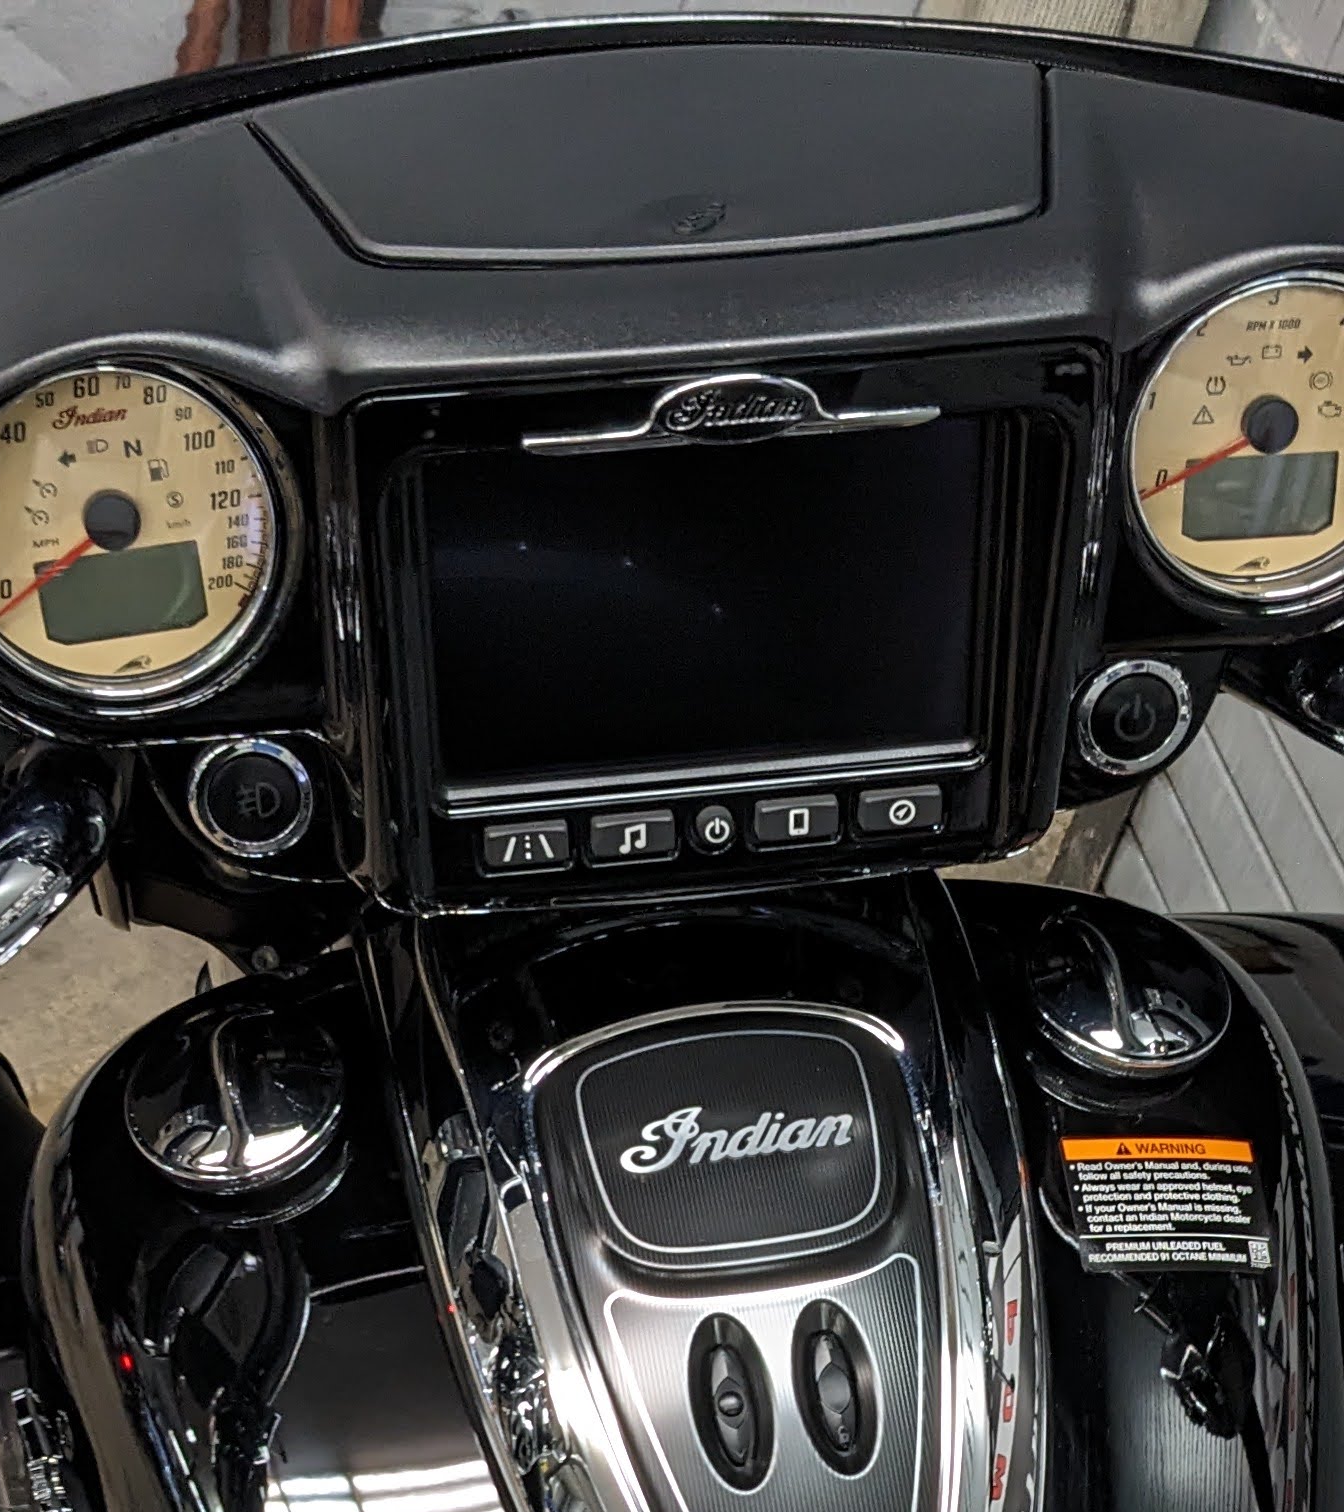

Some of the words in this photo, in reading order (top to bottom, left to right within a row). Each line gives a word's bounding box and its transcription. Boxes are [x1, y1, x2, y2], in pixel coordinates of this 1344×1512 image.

[1246, 319, 1267, 331] RPM
[1278, 318, 1301, 330] 1000
[72, 376, 101, 399] 60
[115, 375, 132, 390] 70
[35, 391, 55, 408] 50
[143, 384, 168, 405] 80
[1147, 391, 1156, 411] 1
[52, 405, 129, 430] Indian
[175, 406, 193, 422] 90
[666, 388, 805, 432] Indian
[0, 421, 27, 445] 40
[183, 430, 216, 452] 100
[215, 459, 235, 475] 110
[1155, 468, 1168, 487] 0
[210, 489, 242, 511] 120
[227, 514, 250, 529] 140
[32, 537, 60, 549] MPH
[226, 535, 249, 550] 160
[222, 556, 244, 571] 180
[0, 578, 13, 600] 0
[208, 575, 234, 591] 200
[620, 1105, 854, 1174] Indian
[1134, 1142, 1207, 1155] WARNING
[1077, 1162, 1103, 1171] Read
[1105, 1162, 1144, 1171] Owner's
[1145, 1161, 1179, 1170] Manual
[1181, 1161, 1202, 1172] and,
[1204, 1162, 1232, 1174] during
[1078, 1172, 1108, 1181] follow
[1109, 1172, 1121, 1181] all
[1122, 1171, 1152, 1182] safety
[1153, 1171, 1211, 1182] precautions.
[1081, 1183, 1116, 1194] Always
[1117, 1184, 1141, 1192] wear
[1142, 1184, 1155, 1192] an
[1156, 1182, 1201, 1194] approved
[1201, 1183, 1236, 1194] helmet,
[1236, 1185, 1253, 1196] eye
[1082, 1193, 1132, 1204] protection
[1133, 1192, 1152, 1201] and
[1153, 1192, 1201, 1203] protective
[1201, 1192, 1241, 1204] clothing.
[1085, 1204, 1093, 1213] If
[1094, 1205, 1116, 1216] your
[1117, 1203, 1157, 1213] Owner's
[1158, 1203, 1193, 1213] Manual
[1194, 1204, 1202, 1212] is
[1086, 1214, 1124, 1223] contact
[1125, 1214, 1138, 1222] an
[1139, 1213, 1170, 1222] Indian
[1171, 1212, 1223, 1225] Motorcycle
[1223, 1214, 1252, 1225] dealer
[1089, 1223, 1104, 1233] for
[1114, 1223, 1176, 1234] replacement.
[1105, 1241, 1151, 1252] PREMIUM
[1152, 1241, 1202, 1251] UNLEADED
[1088, 1252, 1159, 1263] RECOMMENDED
[1160, 1252, 1170, 1262] 91
[1171, 1252, 1207, 1262] OCTANE
[1208, 1252, 1248, 1264] MINIMUM
